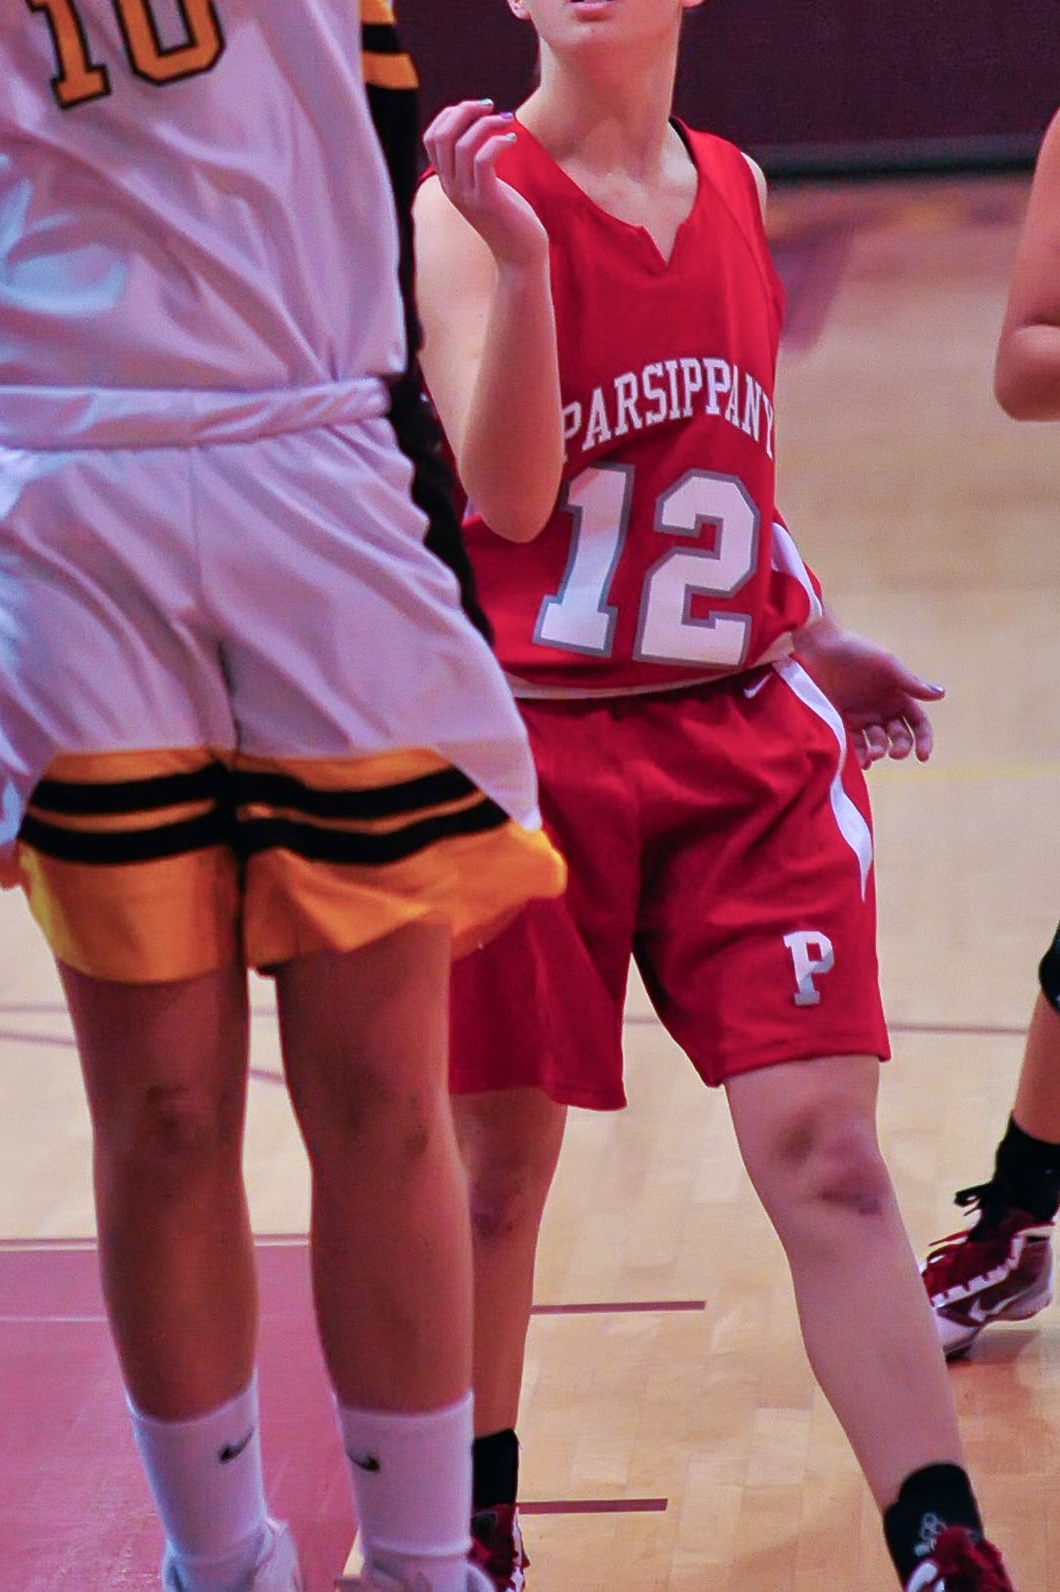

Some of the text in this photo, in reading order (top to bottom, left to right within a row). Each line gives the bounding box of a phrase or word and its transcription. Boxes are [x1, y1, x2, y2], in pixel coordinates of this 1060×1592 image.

[562, 356, 775, 461] PARSIPPANY
[532, 461, 761, 672] 12
[782, 929, 836, 1007] P
